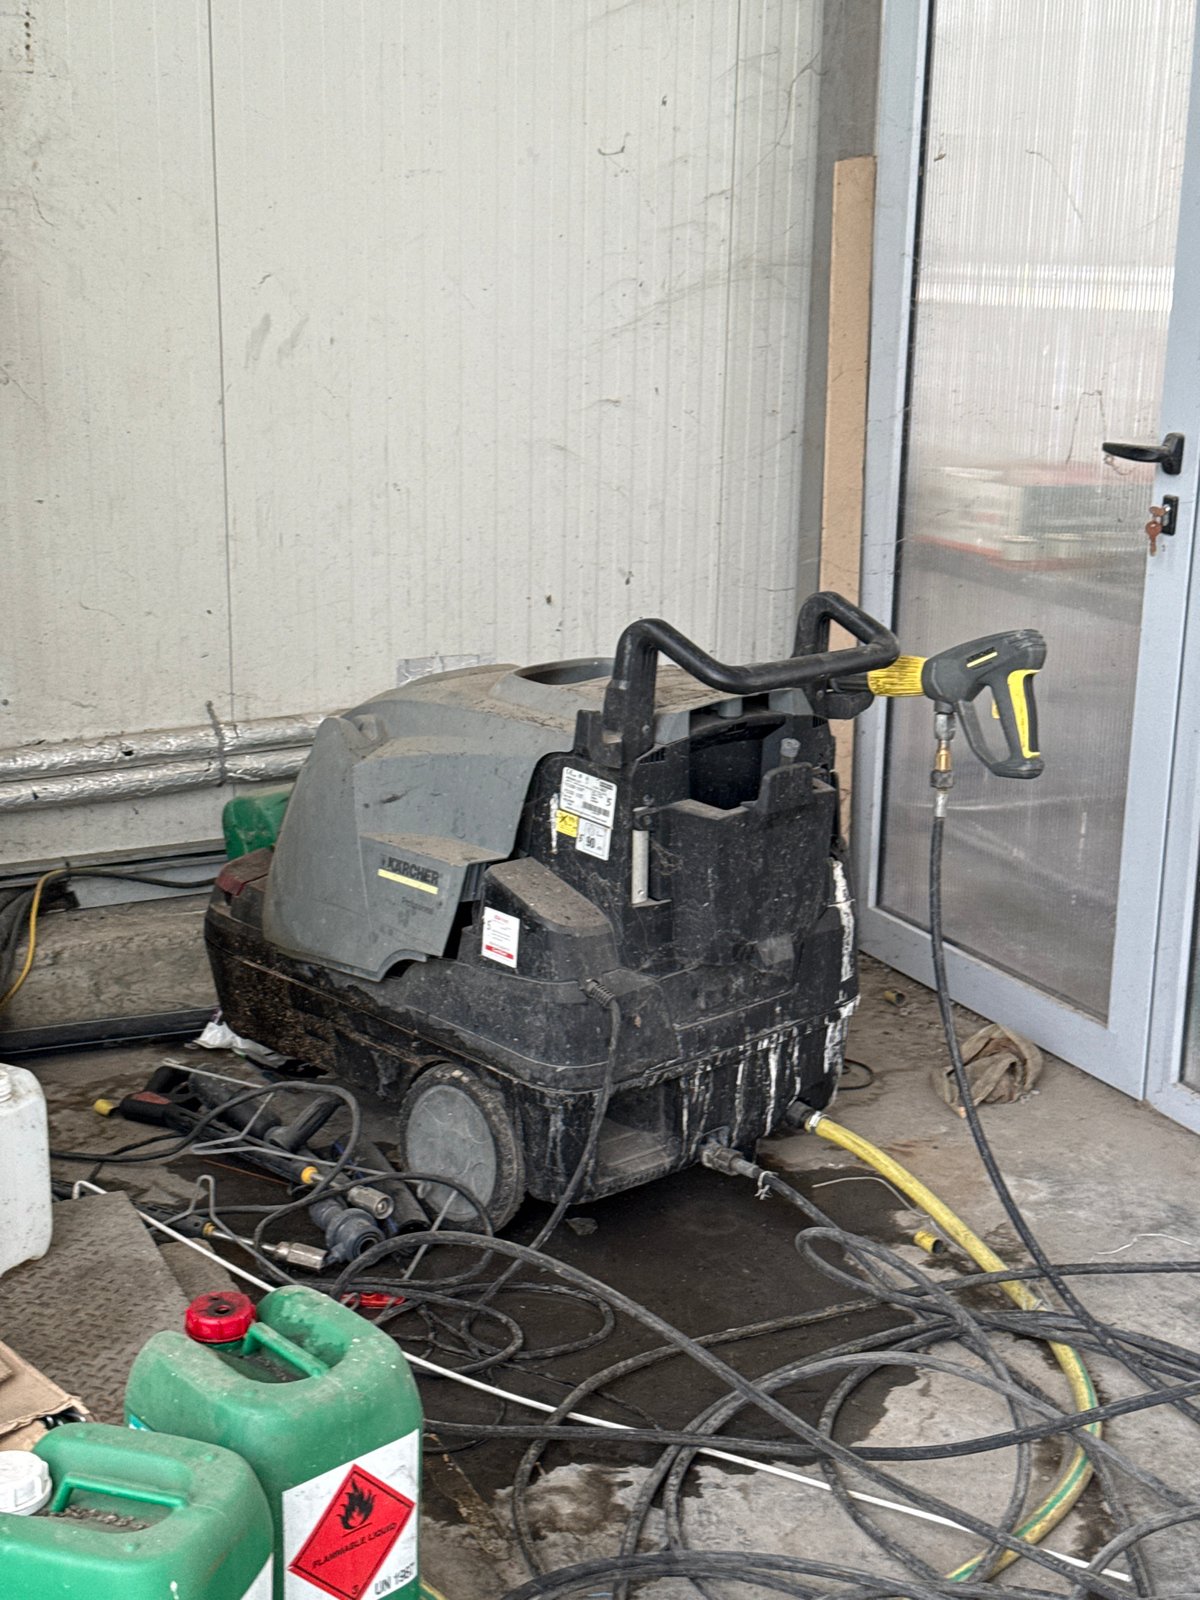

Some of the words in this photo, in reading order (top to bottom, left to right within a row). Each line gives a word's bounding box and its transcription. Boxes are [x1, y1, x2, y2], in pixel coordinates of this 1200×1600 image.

[312, 1536, 367, 1569] FLAMMABLE
[368, 1522, 398, 1541] LIQUID
[352, 1584, 360, 1595] 3
[375, 1576, 391, 1595] UN
